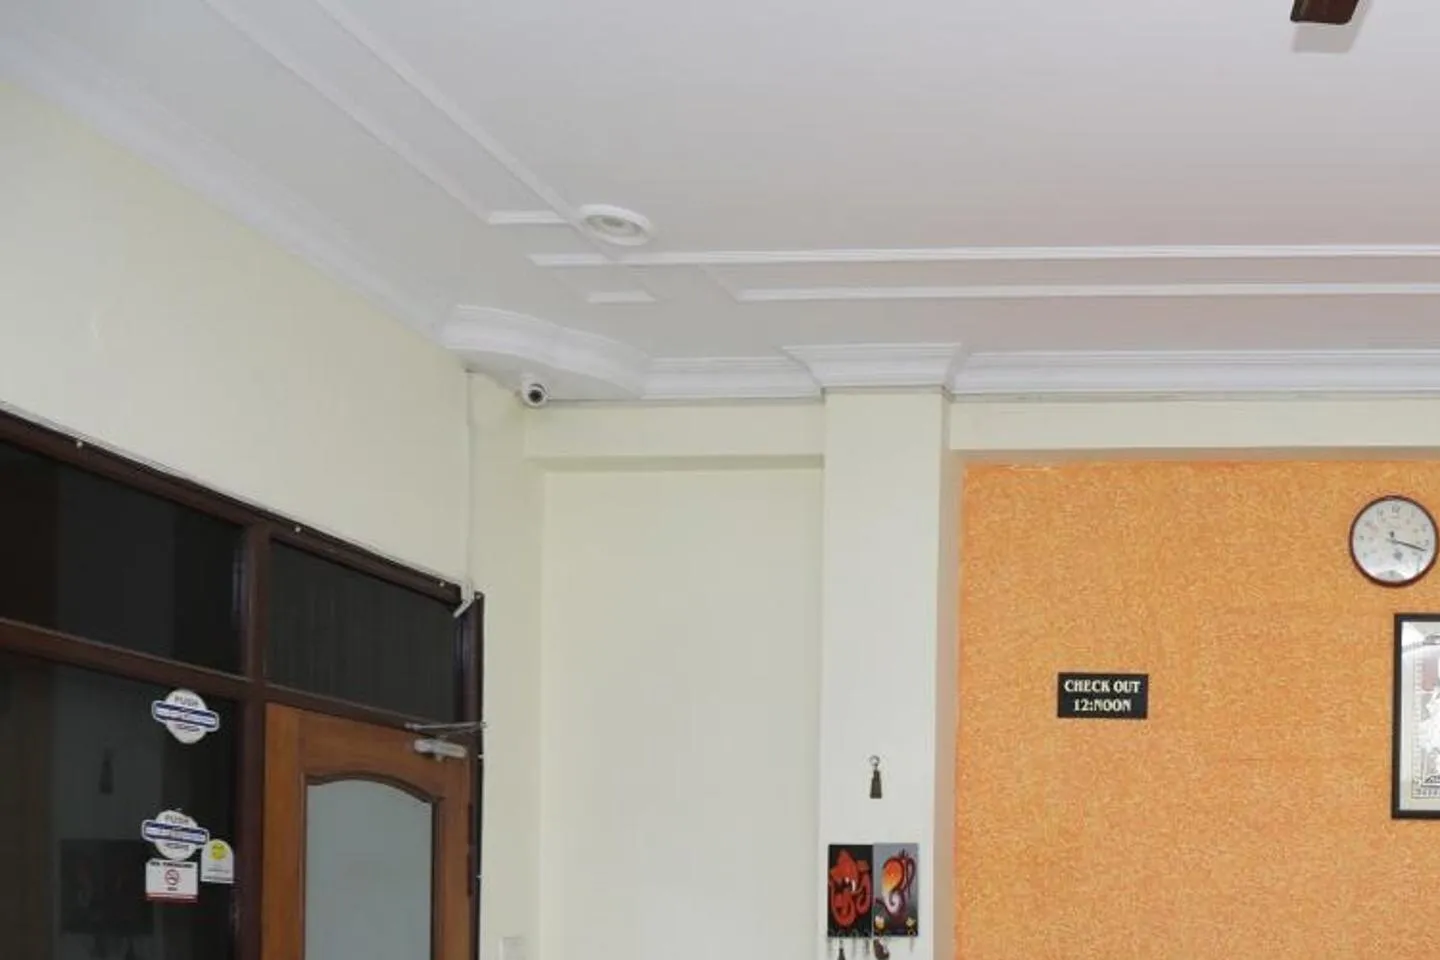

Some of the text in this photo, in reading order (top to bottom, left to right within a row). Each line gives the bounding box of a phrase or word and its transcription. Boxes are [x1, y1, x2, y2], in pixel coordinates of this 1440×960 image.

[1064, 679, 1141, 694] CHECK OUT
[1074, 698, 1132, 712] 12:NOON
